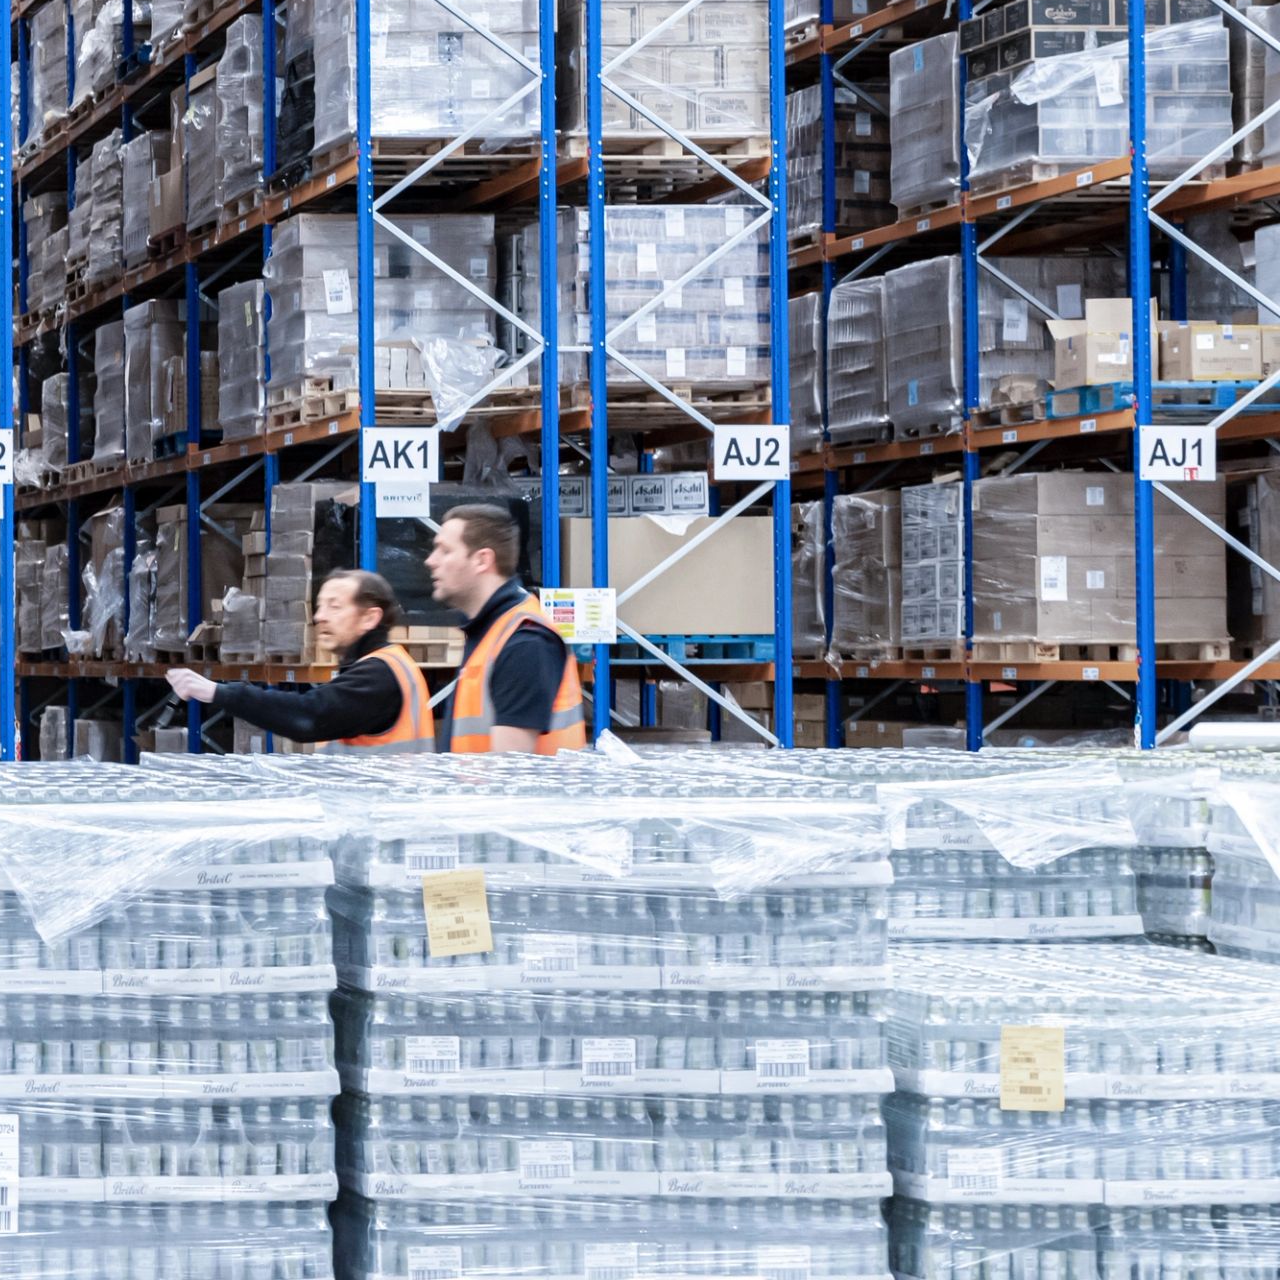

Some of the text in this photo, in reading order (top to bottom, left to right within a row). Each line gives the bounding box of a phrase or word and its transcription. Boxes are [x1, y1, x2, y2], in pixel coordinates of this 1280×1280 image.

[368, 436, 430, 469] AK1
[722, 438, 780, 467] AJ2
[1148, 437, 1202, 467] AJ1
[634, 484, 663, 496] Asahi
[674, 483, 702, 494] Asahi
[197, 870, 234, 885] Britvic
[112, 973, 149, 989] Britvic
[229, 970, 267, 987] Britvic
[24, 1078, 62, 1094] Britvic
[202, 1079, 239, 1094] Britvic
[112, 1181, 149, 1197] Britvic
